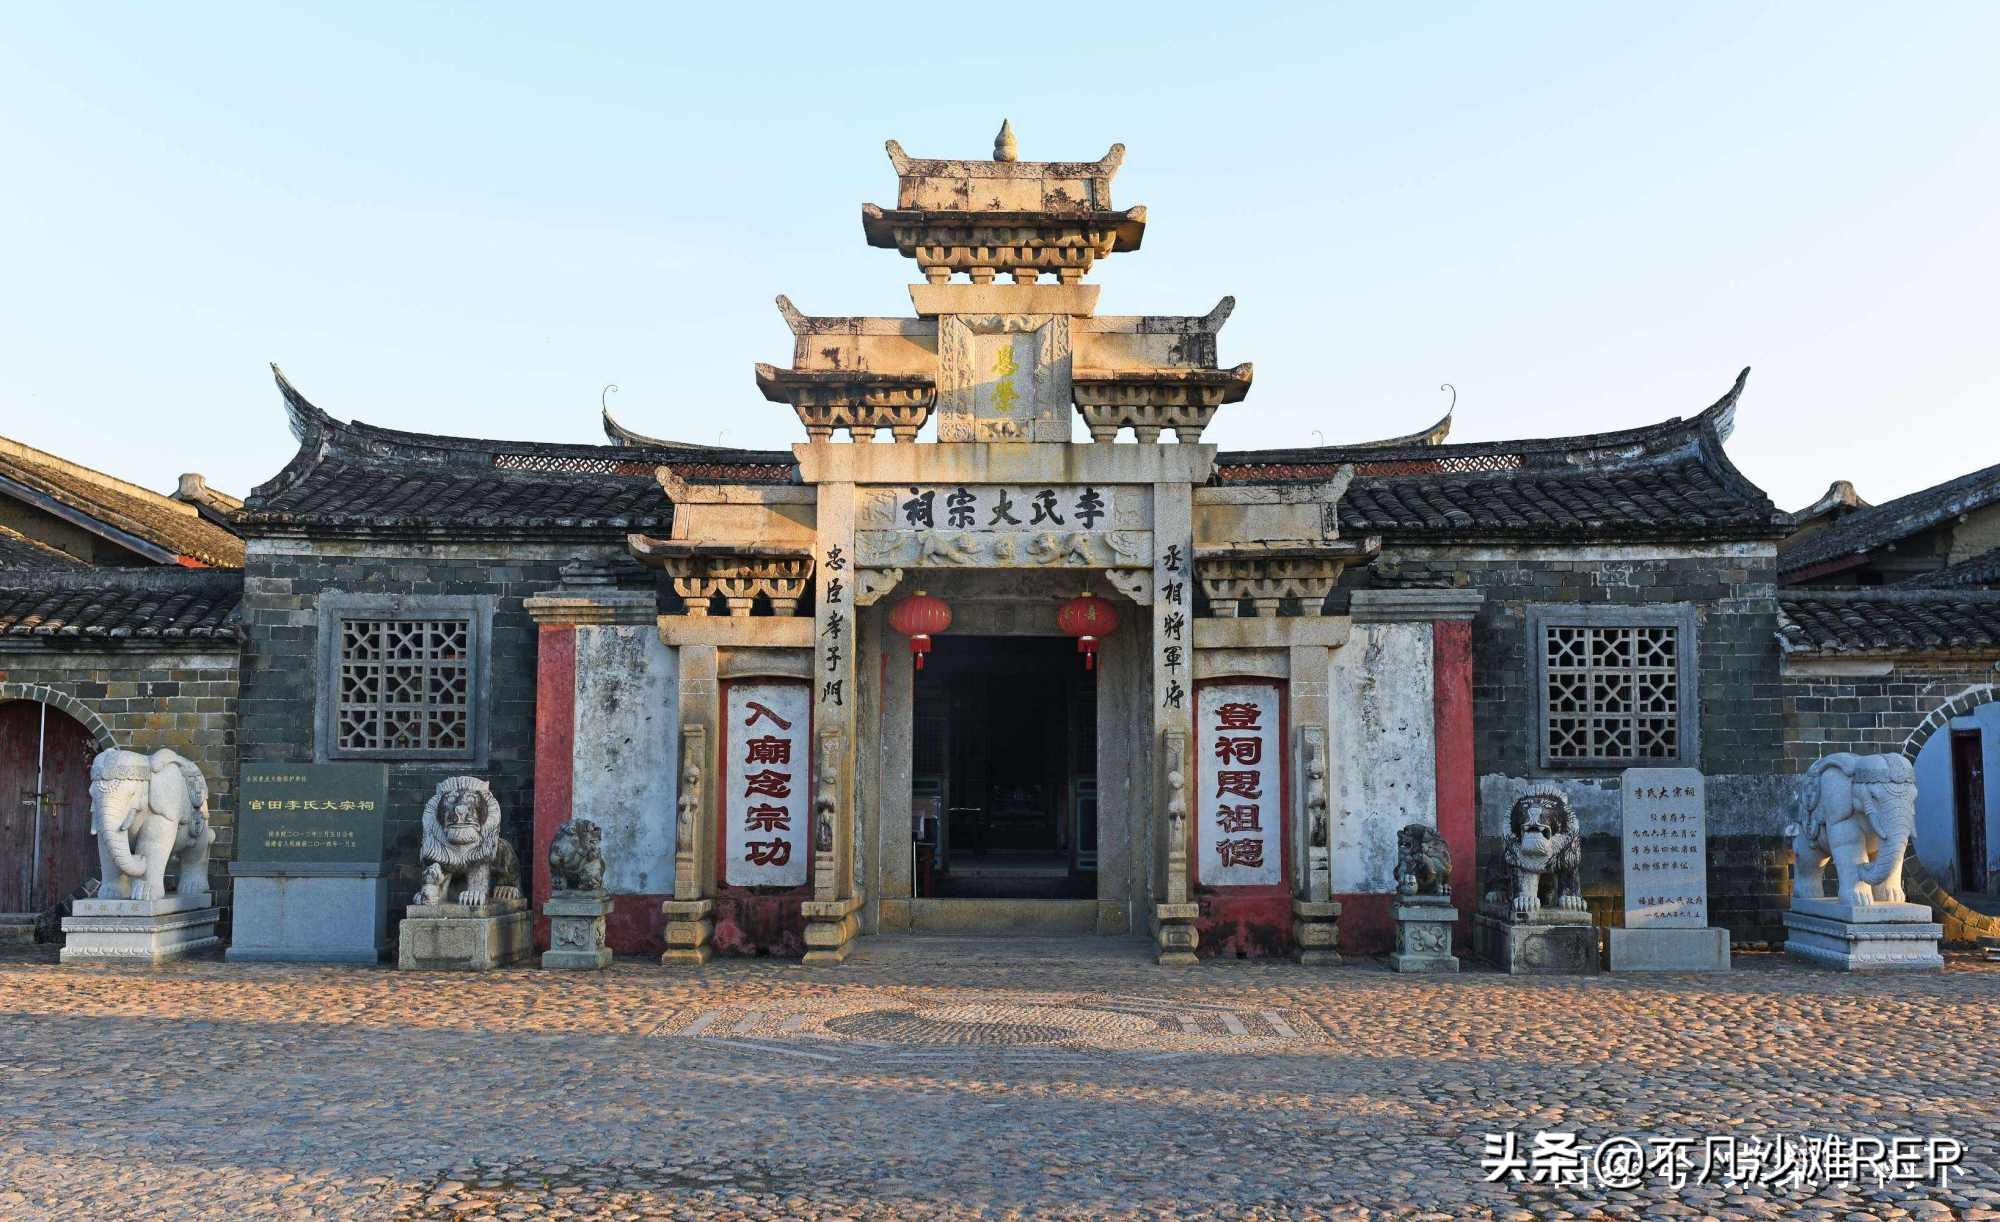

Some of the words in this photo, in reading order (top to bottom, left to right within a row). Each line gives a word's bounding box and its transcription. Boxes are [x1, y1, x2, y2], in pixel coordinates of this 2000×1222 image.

[902, 486, 1105, 530] 李氏大宗祠
[248, 799, 375, 811] 官田李氏大宗祠
[1215, 702, 1264, 868] 登祠思祖德
